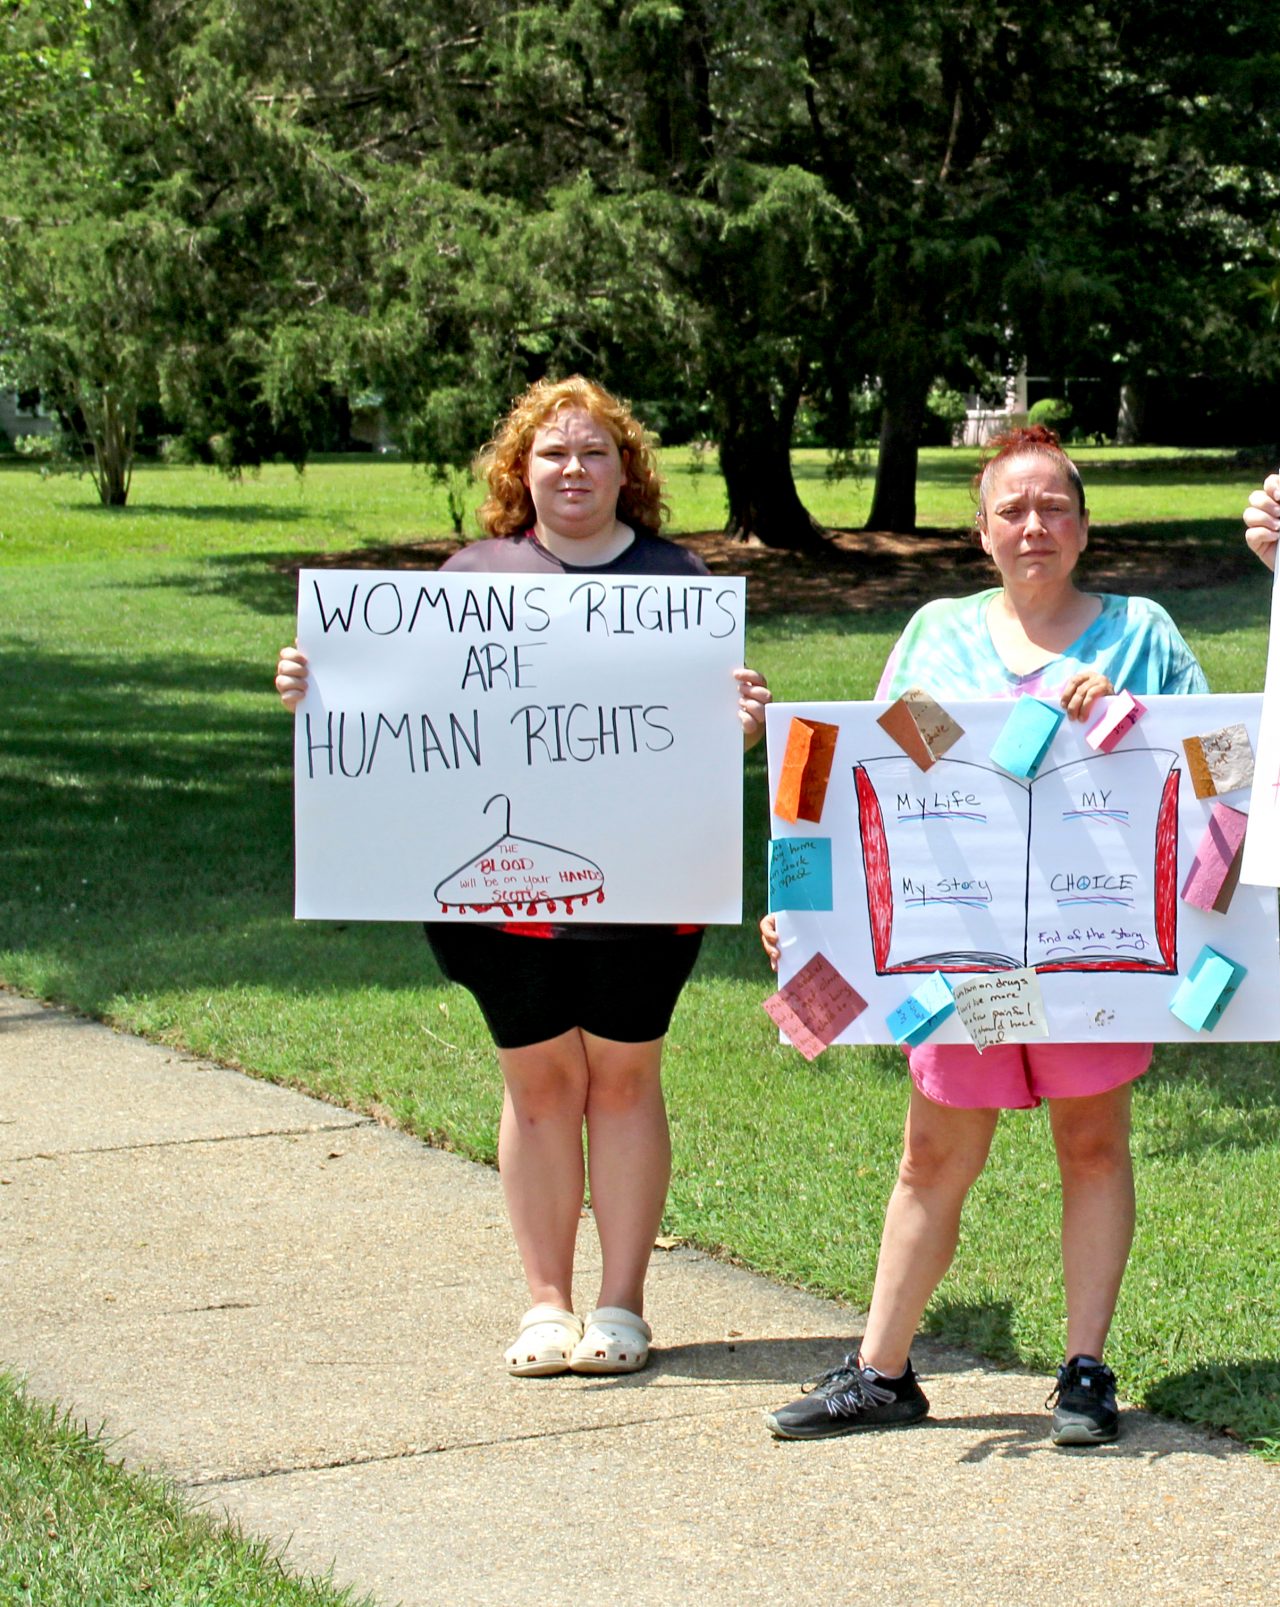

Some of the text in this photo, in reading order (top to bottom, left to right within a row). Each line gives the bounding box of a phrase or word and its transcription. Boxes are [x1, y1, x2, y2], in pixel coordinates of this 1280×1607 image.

[313, 580, 738, 638] WOMANS RIGHTS
[461, 642, 548, 691] ARE
[305, 703, 674, 778] HUMAN RIGHTS
[897, 790, 981, 819] My Life
[1082, 790, 1112, 809] MY
[500, 844, 519, 854] THE
[474, 858, 534, 875] BLOOD
[460, 877, 476, 889] will
[484, 877, 499, 888] be
[504, 876, 517, 884] on
[523, 876, 551, 891] your
[902, 877, 926, 906] My
[1051, 874, 1138, 892] CHOICE
[491, 888, 551, 902] SCOTUS
[1038, 931, 1061, 944] End
[1068, 928, 1081, 940] of
[1086, 928, 1105, 941] the
[996, 978, 1029, 991] drugs
[990, 992, 1020, 1002] more
